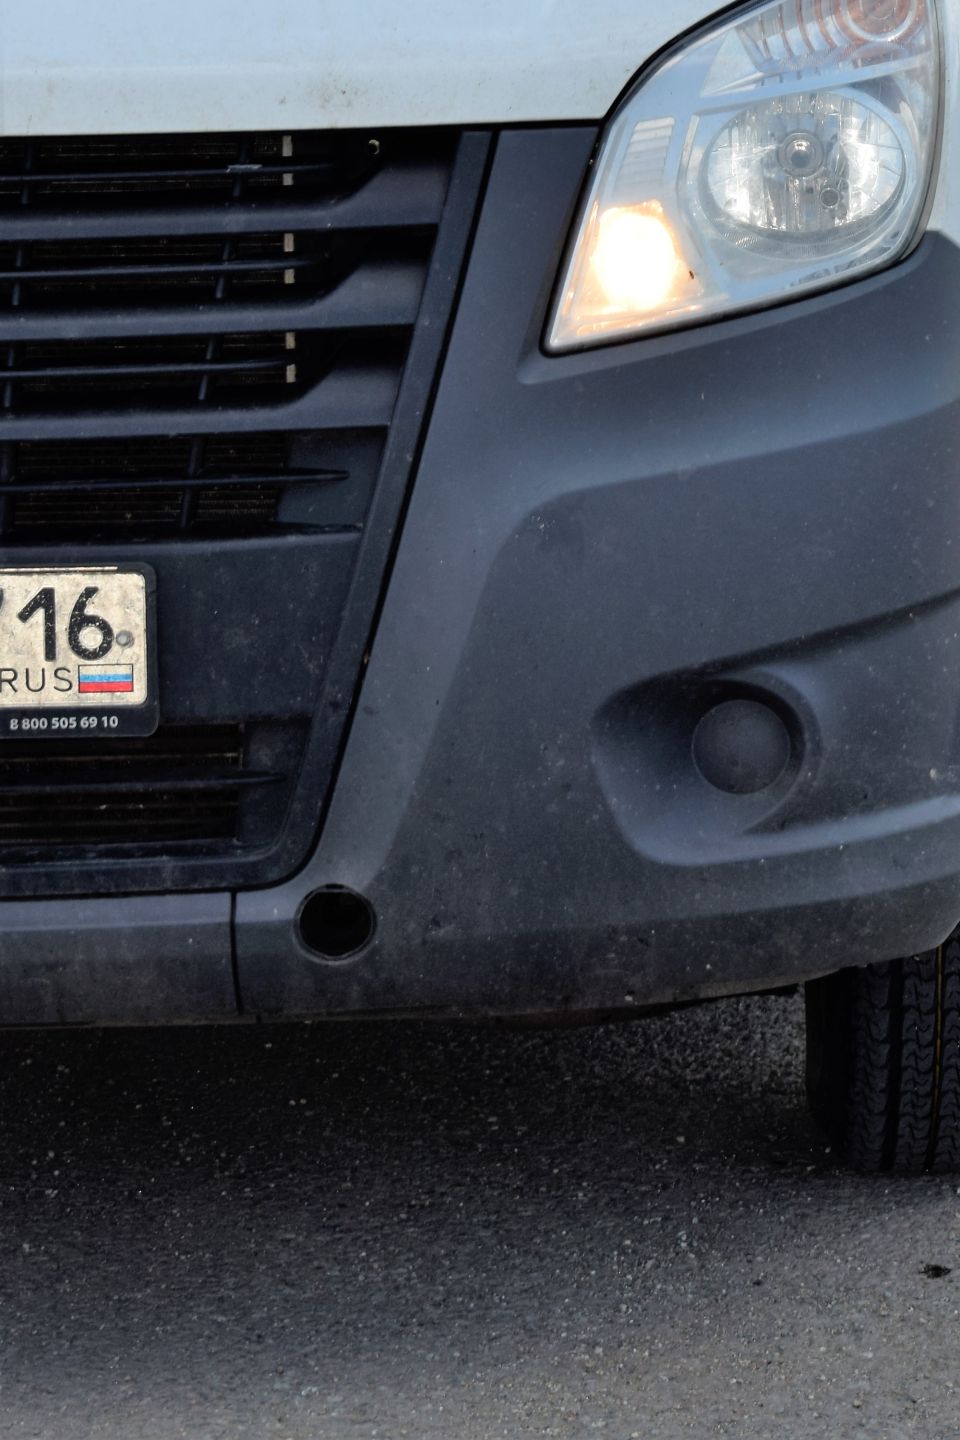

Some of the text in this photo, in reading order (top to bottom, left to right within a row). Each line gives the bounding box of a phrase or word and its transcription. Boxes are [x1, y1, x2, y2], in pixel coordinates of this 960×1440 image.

[0, 586, 114, 662] 16
[0, 667, 73, 693] RUS
[9, 715, 119, 731] 8 800 505 69 10
